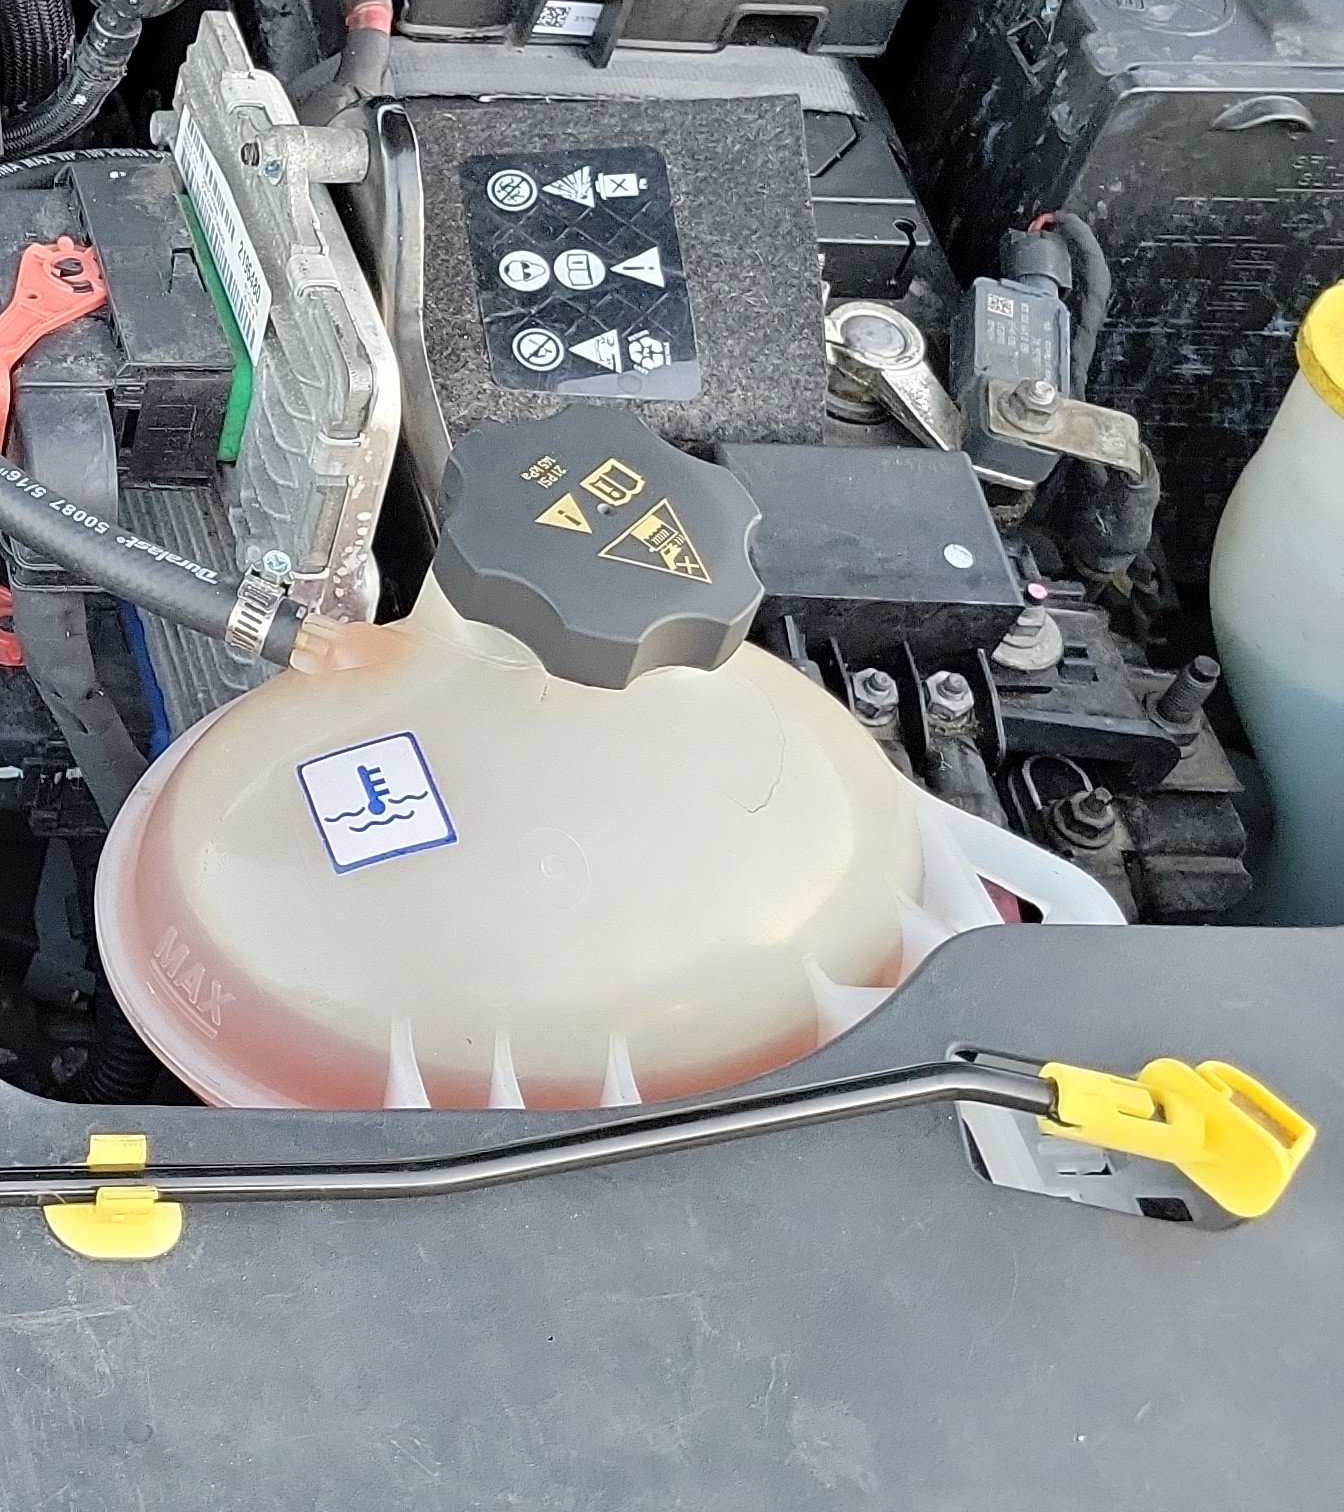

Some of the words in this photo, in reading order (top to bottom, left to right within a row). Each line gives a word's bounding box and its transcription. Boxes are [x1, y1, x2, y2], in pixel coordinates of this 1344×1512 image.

[23, 153, 58, 169] MAX
[536, 455, 557, 470] 145
[550, 464, 567, 477] 21
[521, 464, 545, 480] kPa
[536, 472, 559, 489] PSI
[49, 499, 111, 534] 50087
[153, 924, 237, 1027] MAX
